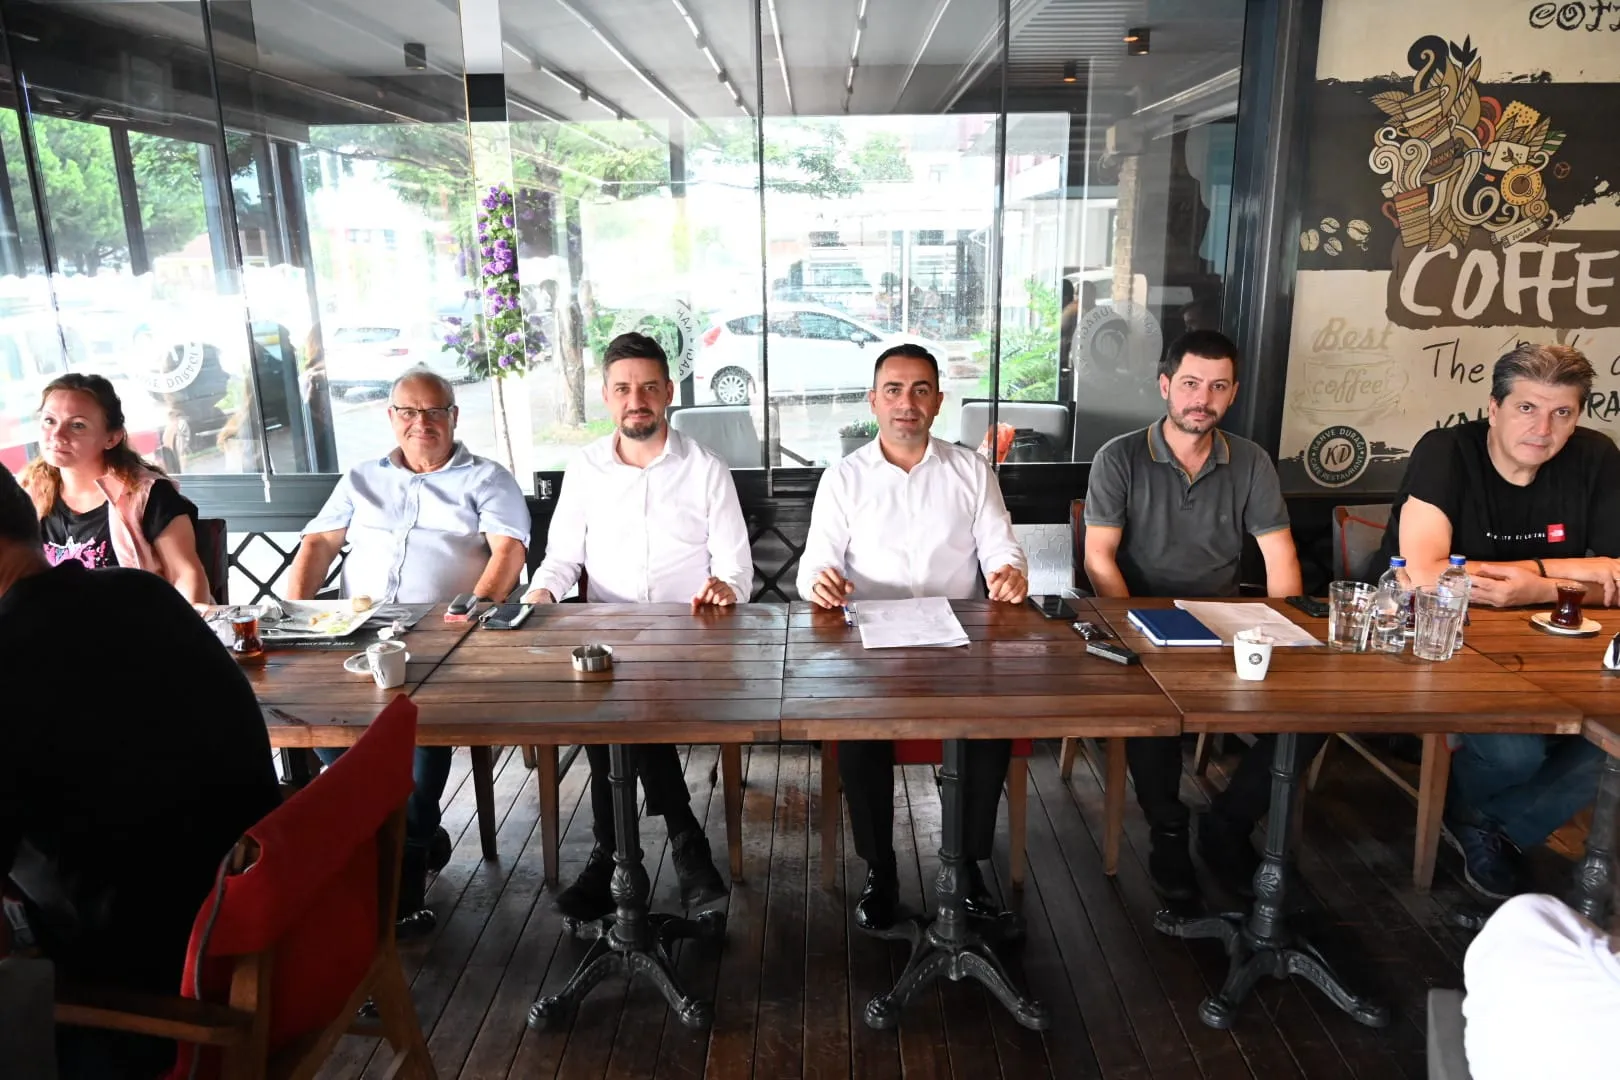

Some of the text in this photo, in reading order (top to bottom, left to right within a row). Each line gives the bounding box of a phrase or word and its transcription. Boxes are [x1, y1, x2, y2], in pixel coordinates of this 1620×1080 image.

[1312, 317, 1393, 353] Best
[1423, 338, 1485, 384] The
[1312, 368, 1384, 403] coffee
[1312, 429, 1337, 451] KAHVE
